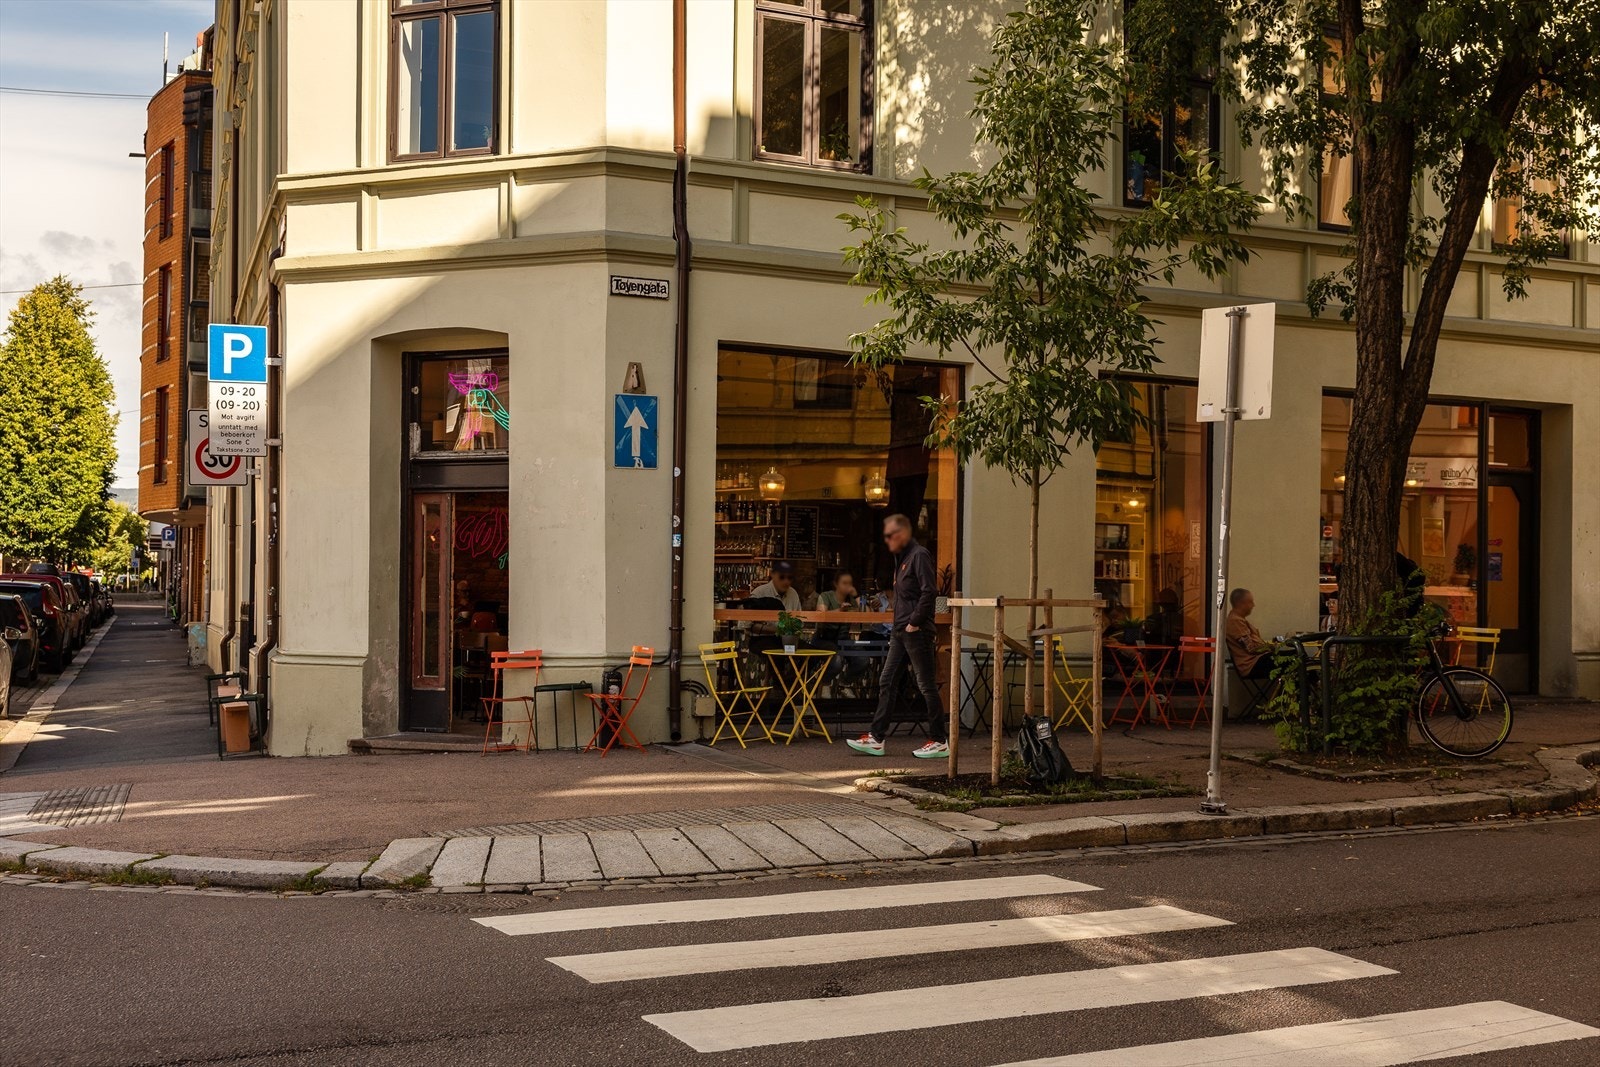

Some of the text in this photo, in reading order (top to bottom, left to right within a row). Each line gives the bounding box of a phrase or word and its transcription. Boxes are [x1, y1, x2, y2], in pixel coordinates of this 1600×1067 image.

[613, 279, 667, 294] Tøyengata
[223, 332, 253, 374] P
[165, 529, 173, 540] P
